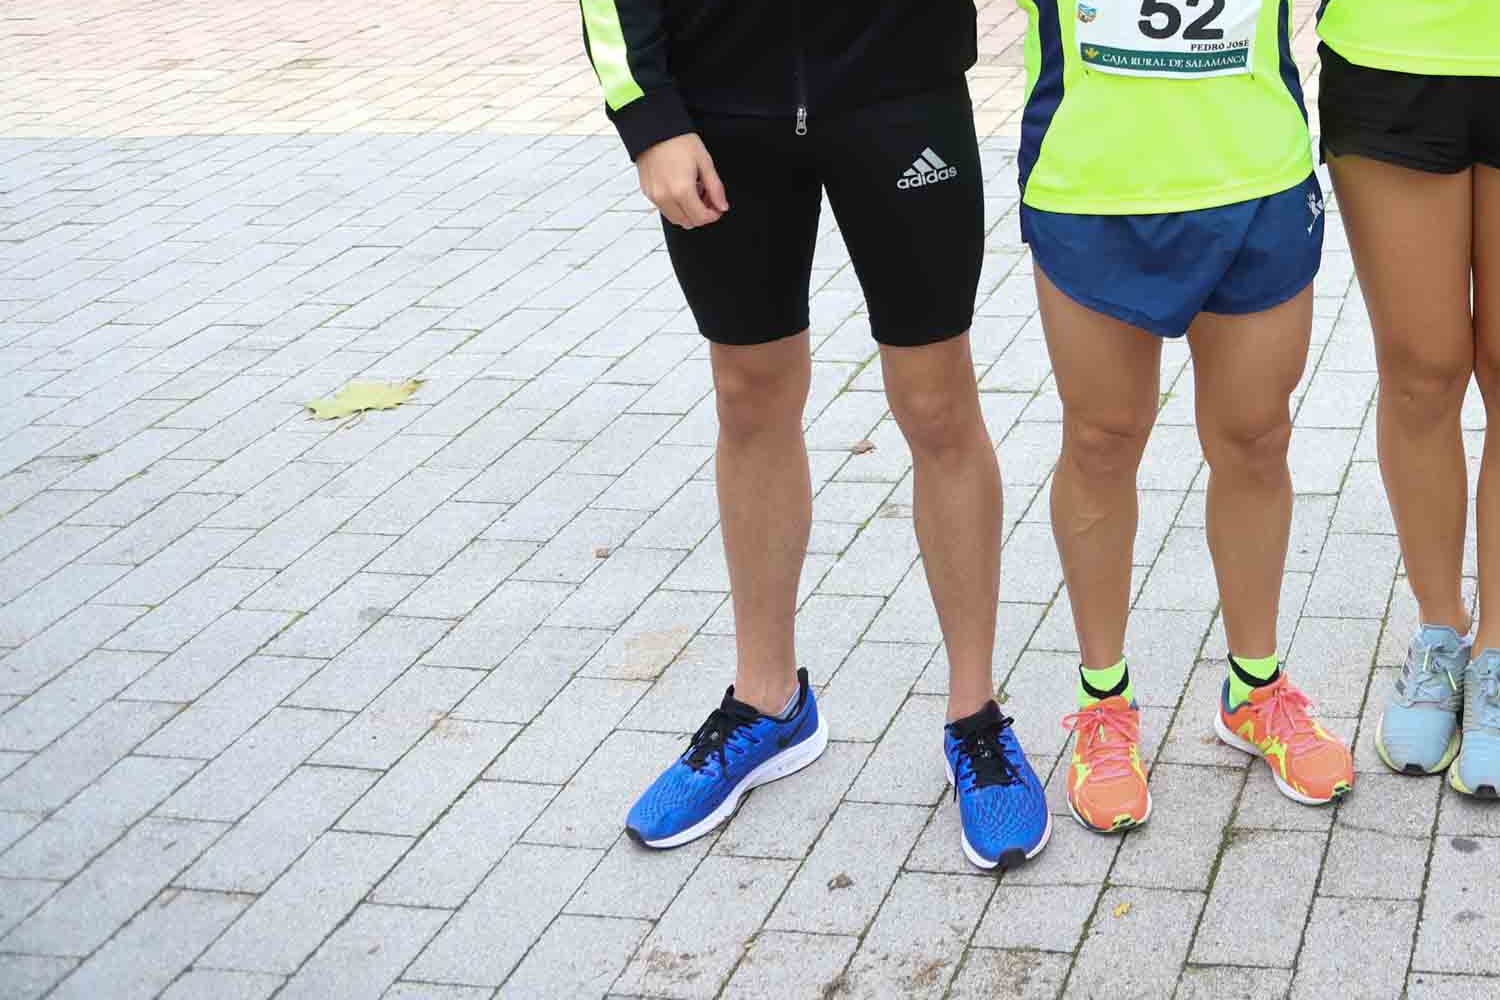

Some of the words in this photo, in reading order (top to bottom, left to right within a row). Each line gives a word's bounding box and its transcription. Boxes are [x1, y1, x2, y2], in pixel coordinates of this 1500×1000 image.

[1191, 42, 1225, 51] PEDRO
[1103, 54, 1128, 65] CAJA
[1130, 57, 1166, 67] RURAL
[1169, 59, 1183, 68] DE
[1185, 55, 1246, 69] SALAMANCA
[896, 166, 957, 189] adidas
